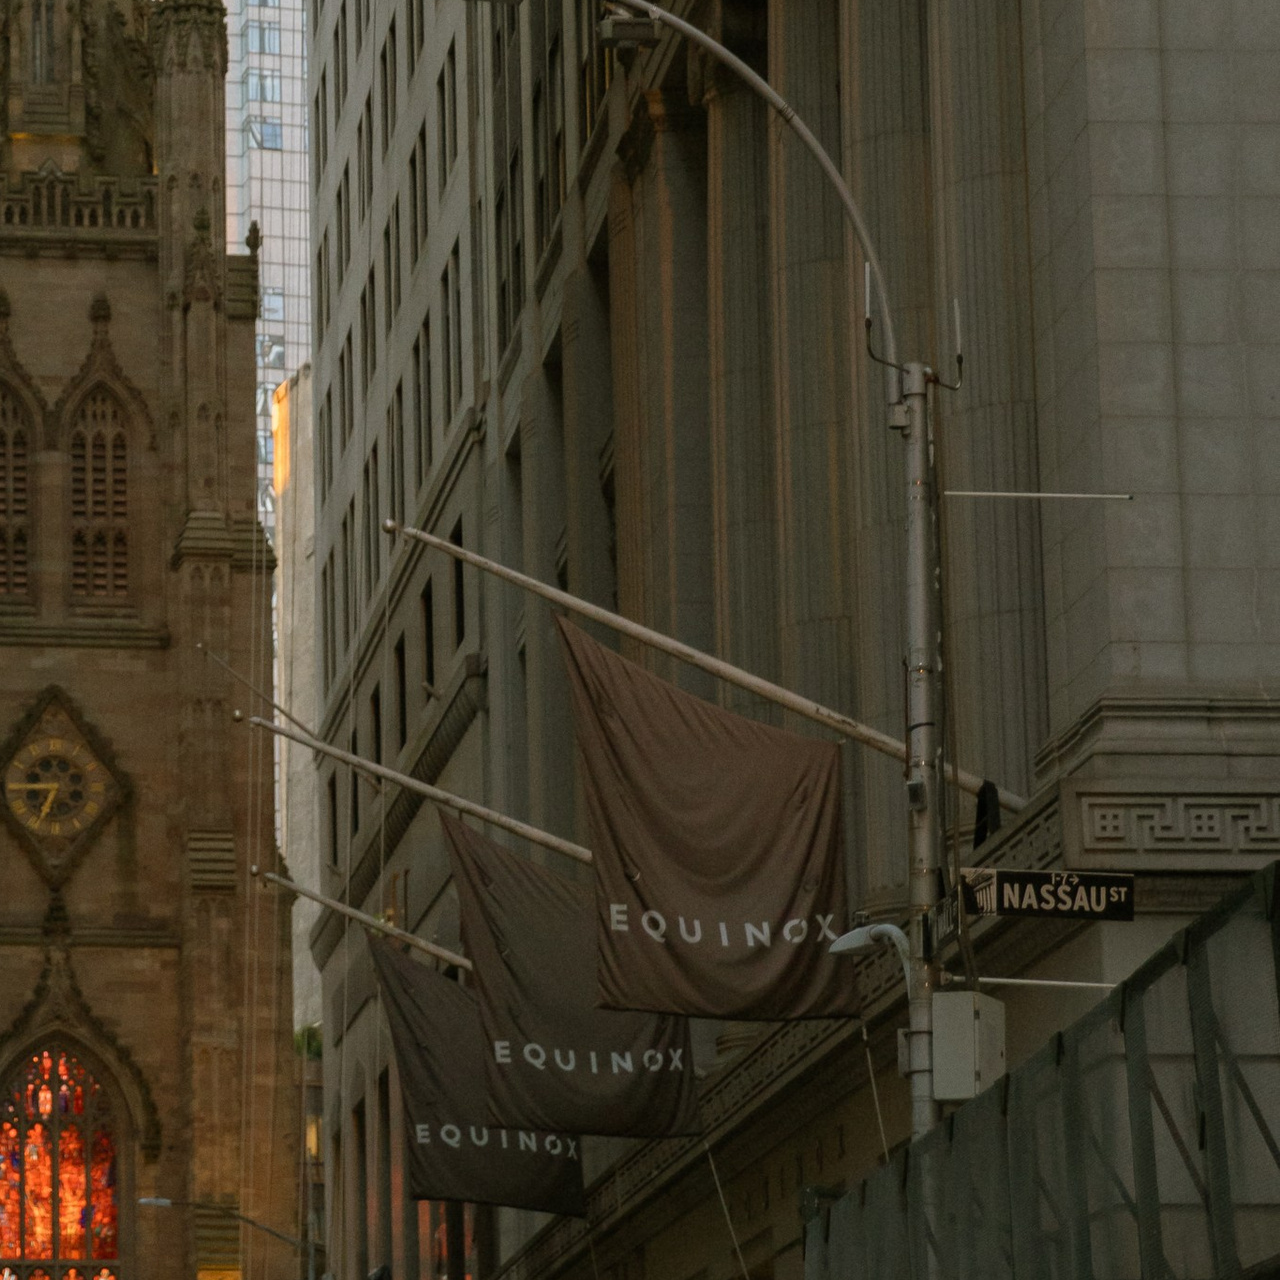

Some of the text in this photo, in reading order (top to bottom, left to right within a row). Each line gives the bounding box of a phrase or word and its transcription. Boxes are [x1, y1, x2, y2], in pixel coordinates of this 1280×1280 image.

[1003, 883, 1128, 913] NASSAU ST
[610, 903, 838, 947] EQUINOX
[494, 1040, 684, 1074] EQUINOX
[415, 1123, 578, 1160] EQUINOX
